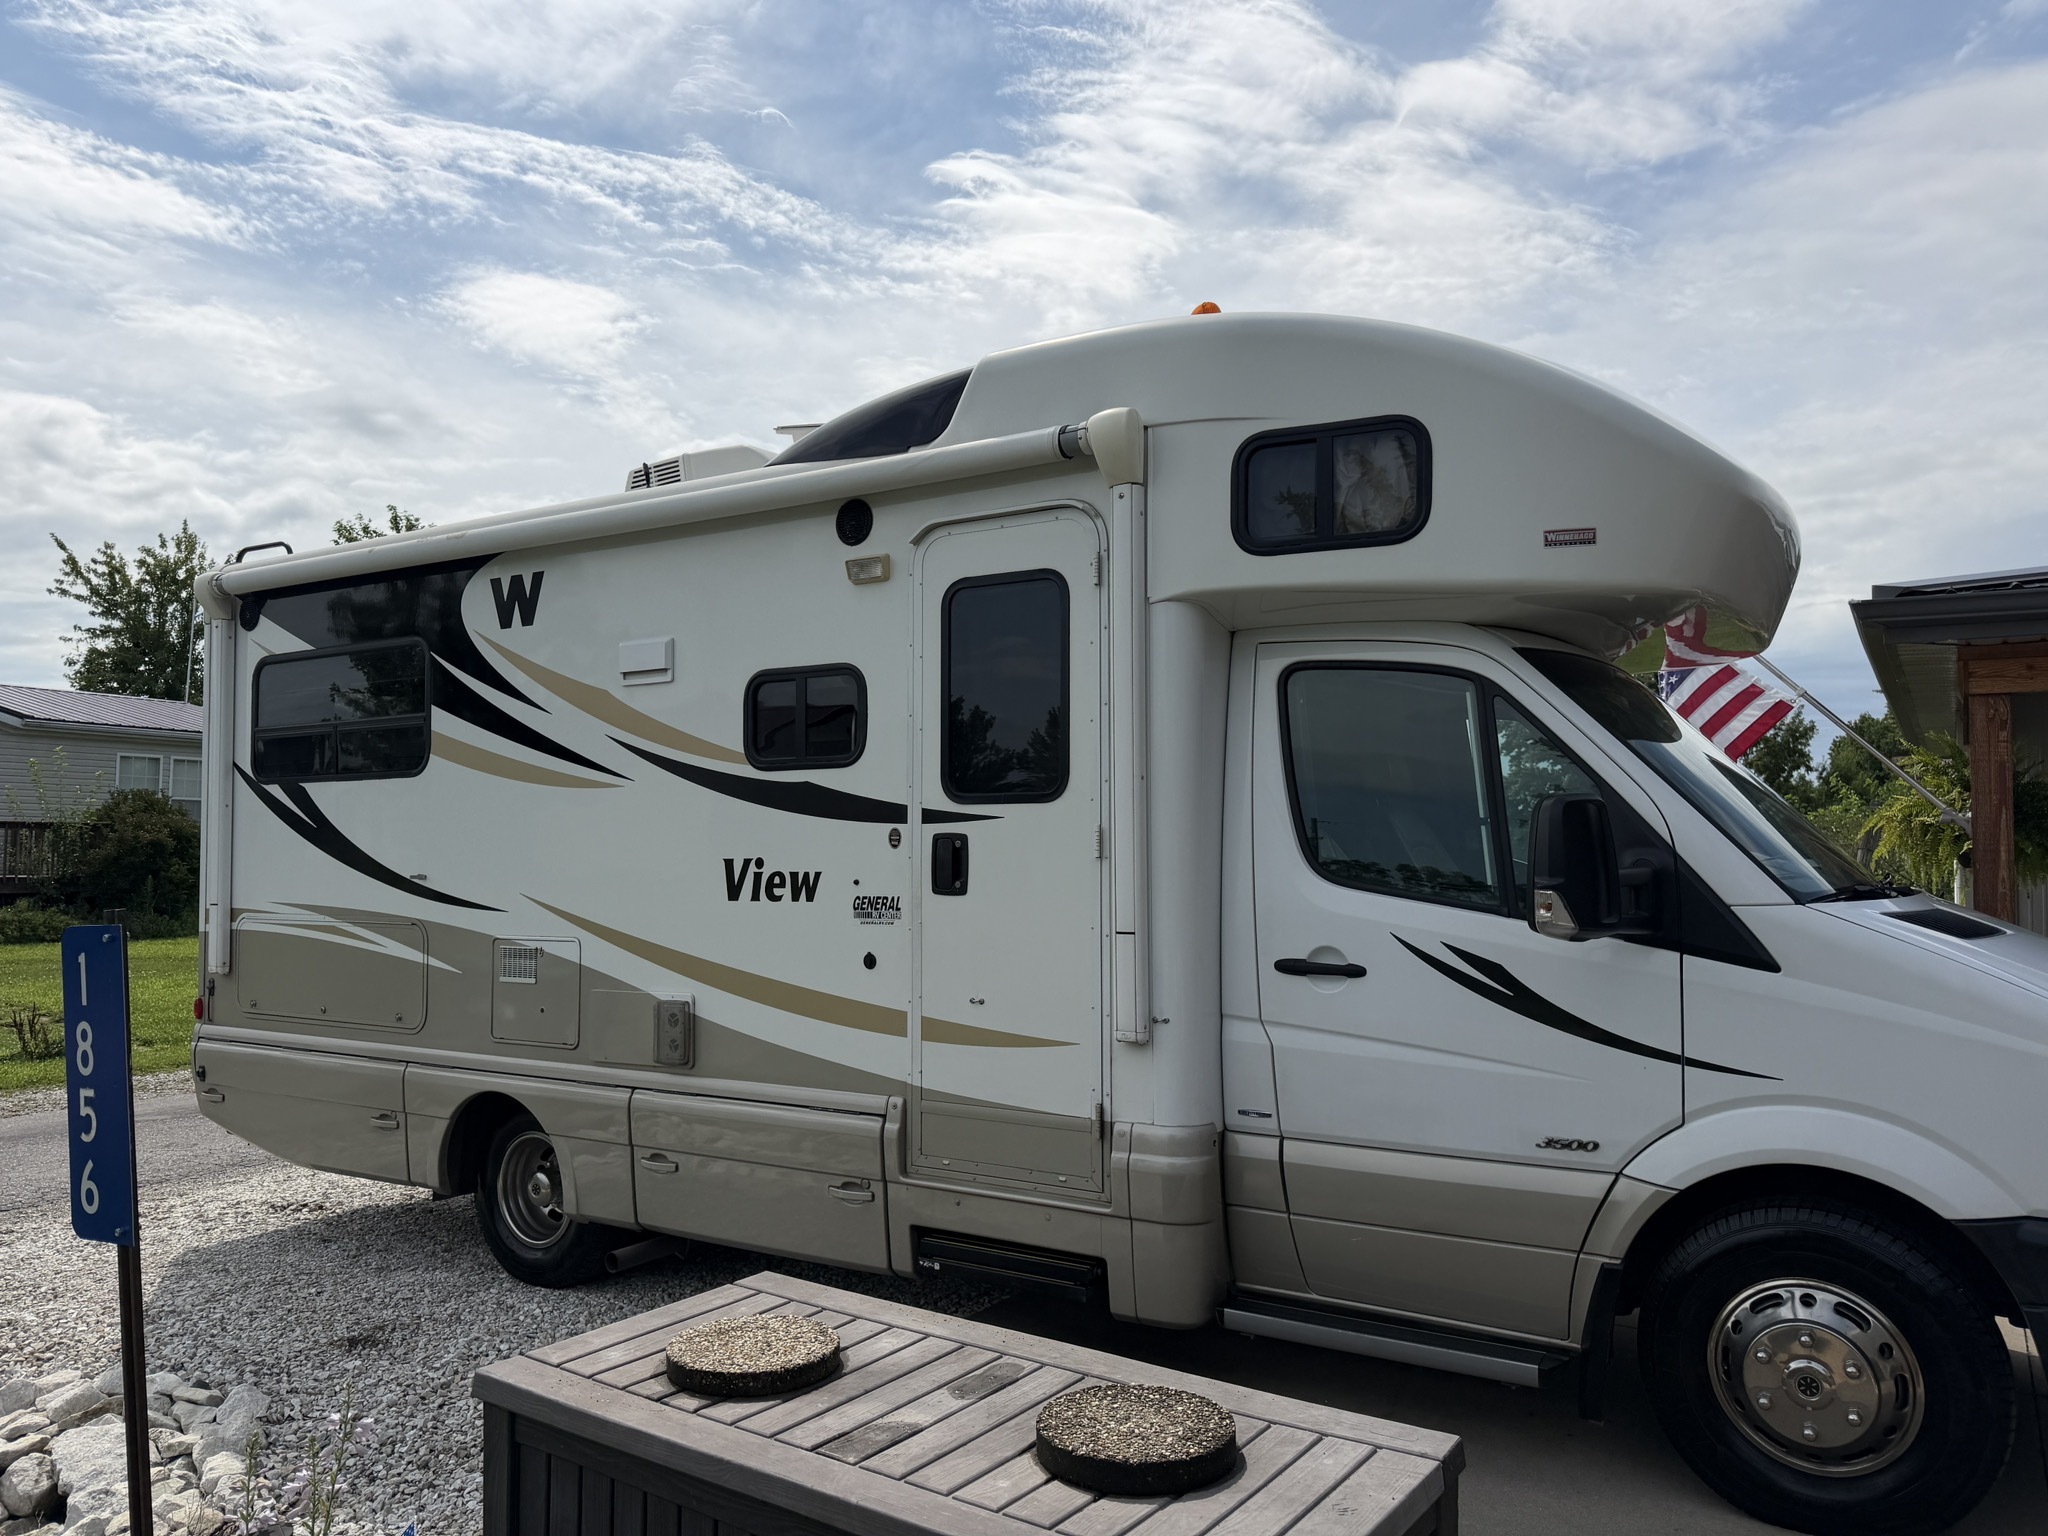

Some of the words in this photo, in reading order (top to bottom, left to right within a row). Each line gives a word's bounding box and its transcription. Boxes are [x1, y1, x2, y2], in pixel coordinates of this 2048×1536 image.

[489, 570, 545, 630] W
[722, 856, 823, 903] View
[853, 895, 901, 911] GENERAL
[76, 952, 100, 1215] 1856
[1535, 1136, 1600, 1152] 3500
